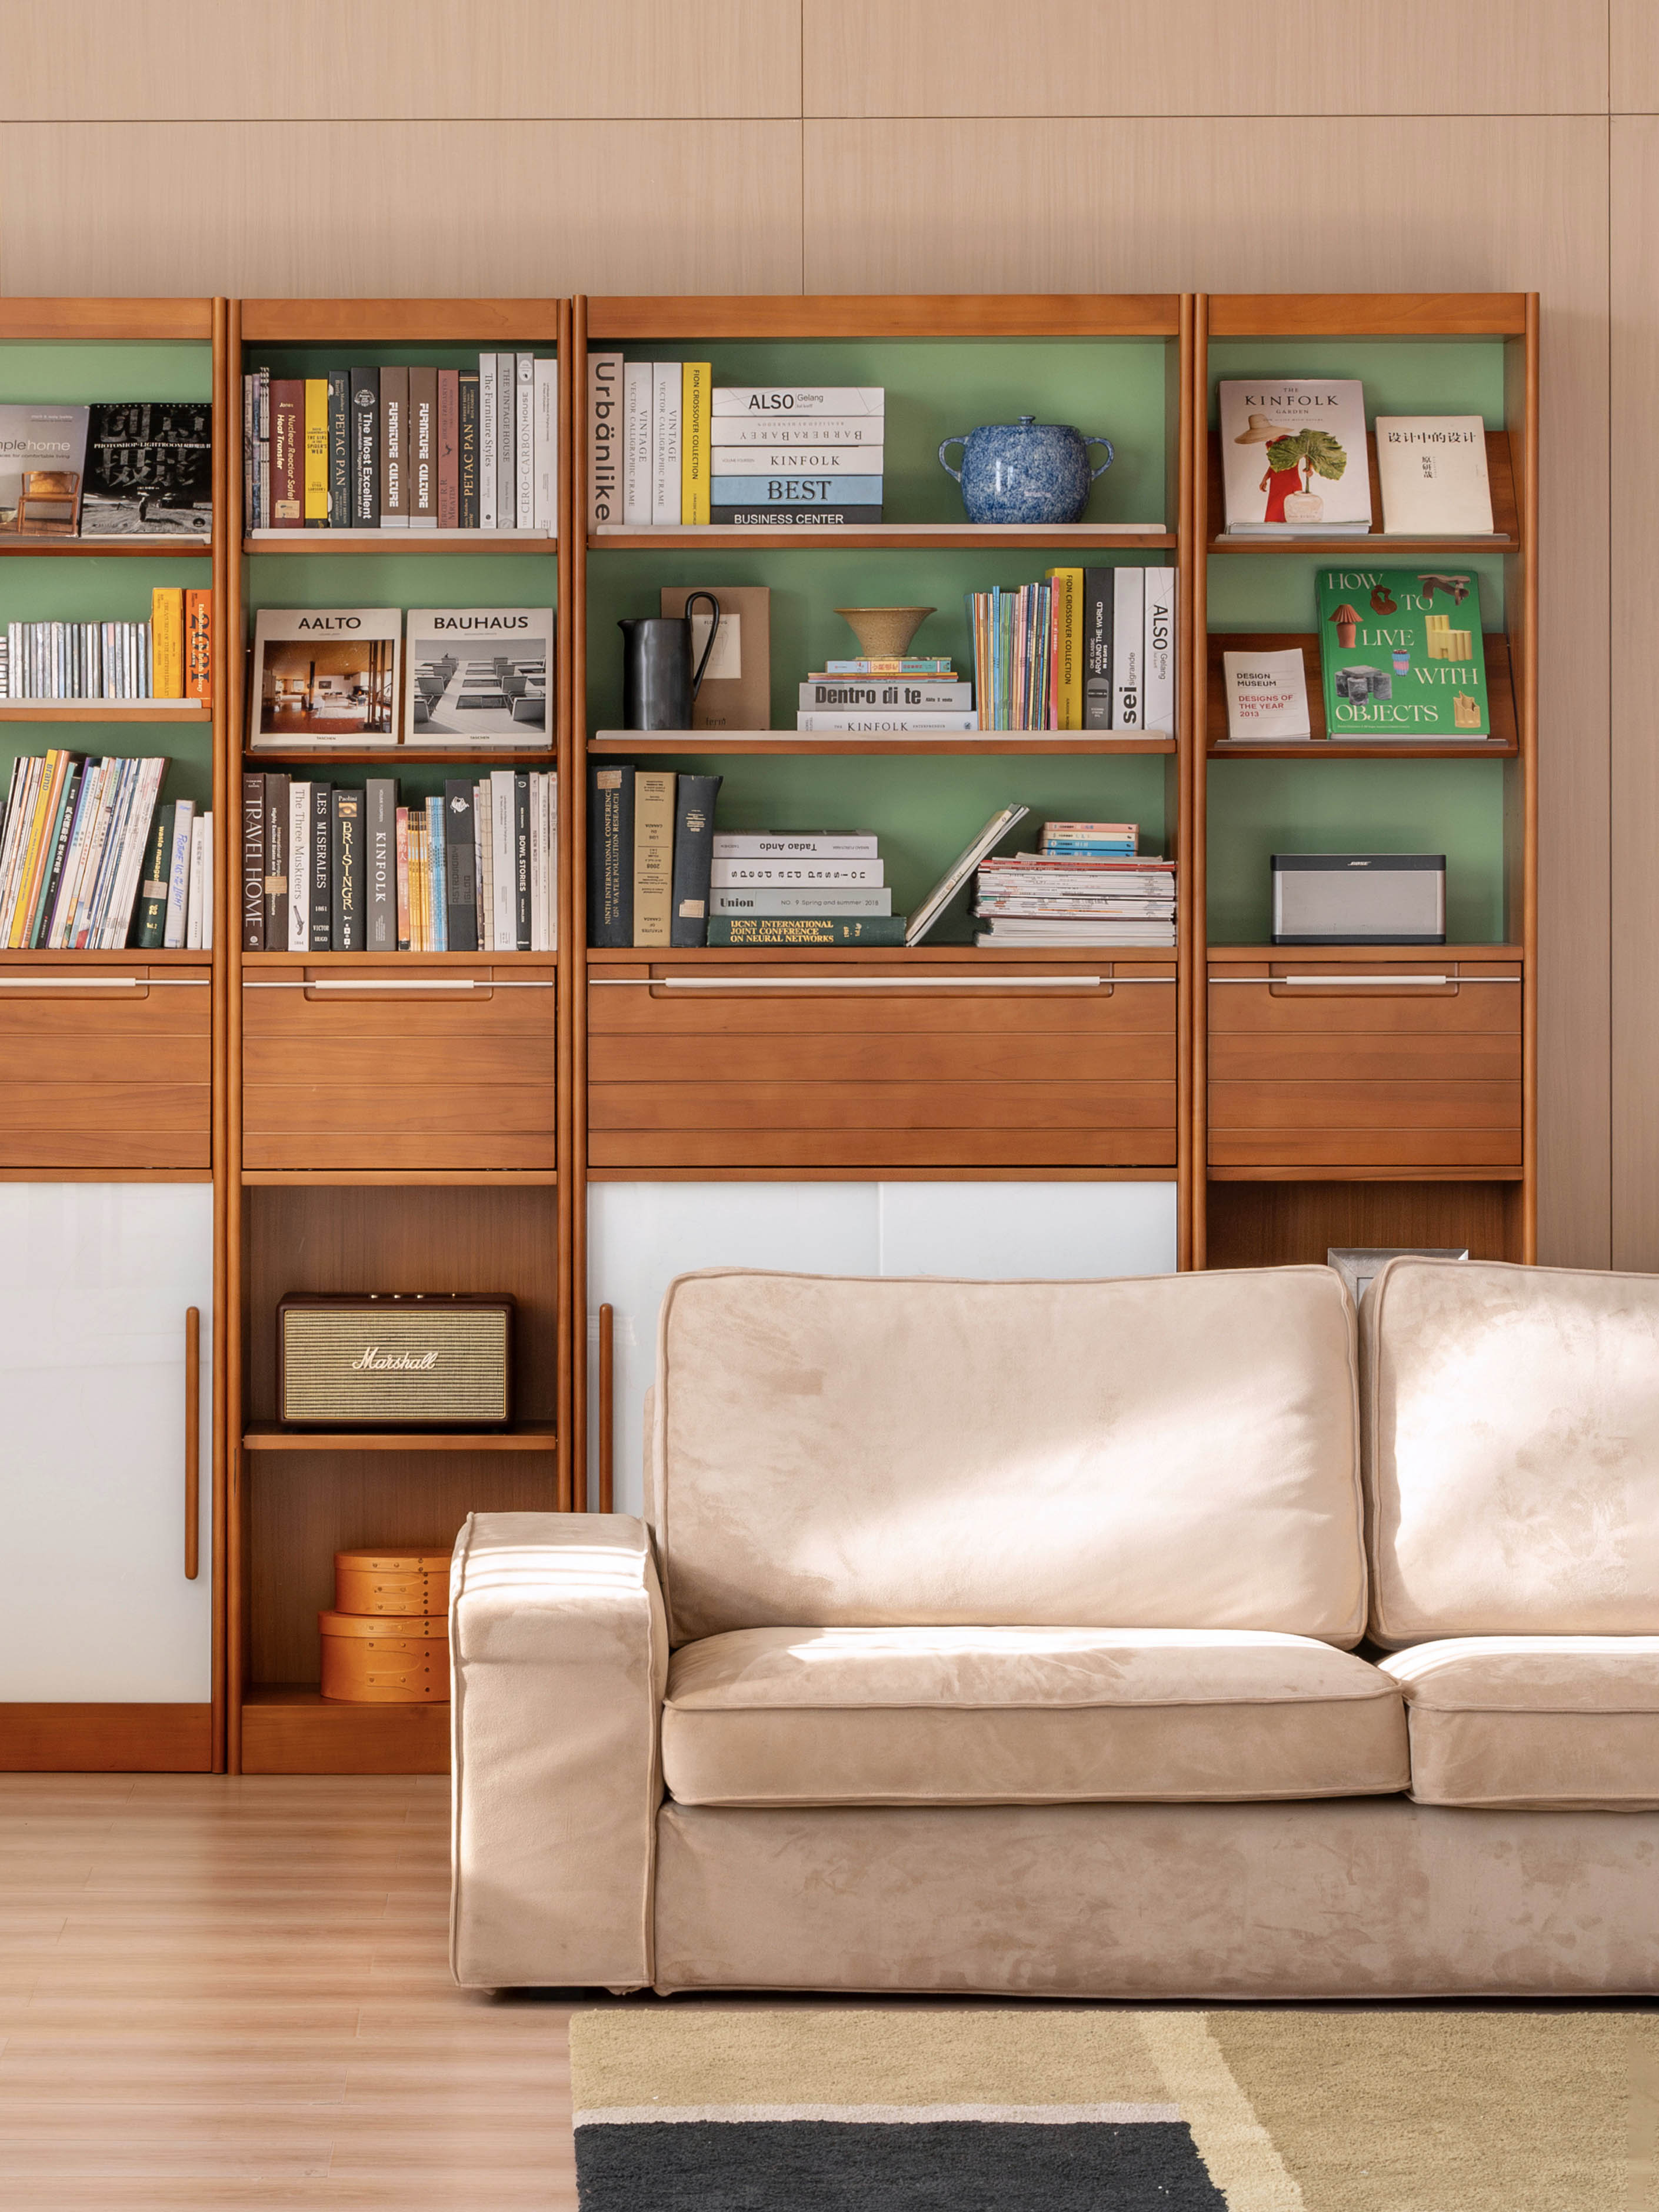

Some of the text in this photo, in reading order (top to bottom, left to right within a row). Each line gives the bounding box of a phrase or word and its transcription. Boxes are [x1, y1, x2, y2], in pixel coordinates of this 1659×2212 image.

[485, 373, 493, 390] The
[749, 394, 794, 409] ALSO
[797, 394, 824, 402] Gelang
[1245, 395, 1338, 405] KINFOLK
[276, 415, 285, 434] Heat
[485, 392, 493, 438] Furniture
[287, 415, 296, 447] Nuclear
[335, 414, 346, 455] PETAC
[595, 362, 615, 521] Urbänlike
[639, 410, 647, 462] VINTAGE
[668, 410, 677, 462] VINTAGE
[1388, 432, 1476, 443] 设计中的设计
[464, 424, 474, 495] PETAC PAN
[483, 440, 493, 467] Styles
[771, 456, 840, 466] KINFOLK
[336, 460, 346, 485] PAN
[363, 412, 372, 519] The Most Excellent
[287, 479, 295, 500] Safet
[389, 462, 398, 508] CULTURE
[419, 463, 429, 508] CULTURE
[768, 481, 832, 500] BEST
[734, 514, 844, 524] BUSINESS CENTER
[1328, 573, 1383, 589] HOW
[1401, 594, 1433, 611] TO
[298, 618, 361, 629] AALTO
[434, 617, 529, 629] BAUHAUS
[1152, 605, 1168, 680] ALSO Gelang
[1362, 629, 1414, 645] LIVE
[1414, 668, 1478, 684] WITH
[815, 686, 921, 704] Dentro di te
[1119, 687, 1137, 724] sei
[1335, 705, 1439, 722] OBJECTS
[848, 722, 909, 731] KINFOLK
[296, 790, 305, 808] The
[317, 792, 327, 814] LES
[245, 797, 262, 863] TRAVEL
[295, 812, 304, 842] Three
[759, 842, 817, 851] Tadao Ando
[342, 822, 353, 910] BRISINGR
[376, 832, 386, 902] KINFOLK
[245, 868, 262, 928] HOME
[720, 898, 754, 907] Union
[352, 1346, 439, 1371] Marshall
